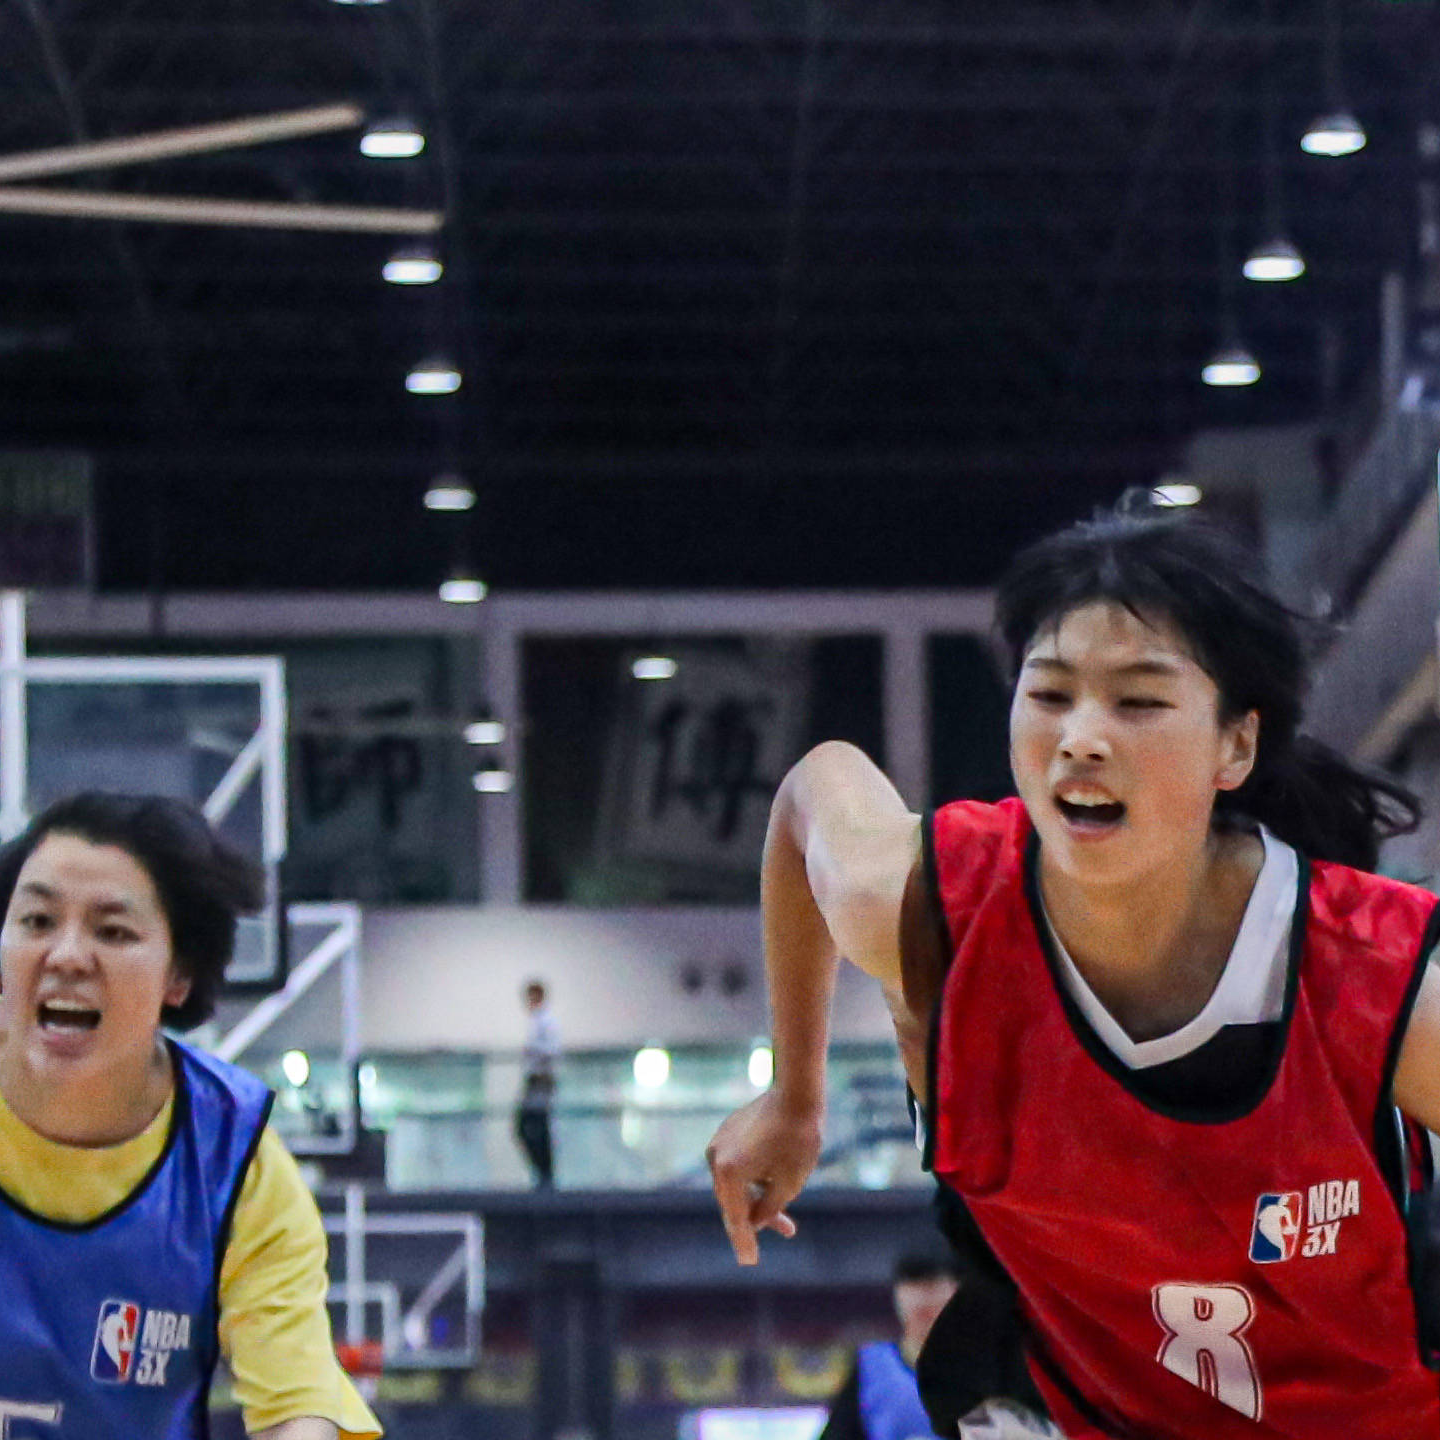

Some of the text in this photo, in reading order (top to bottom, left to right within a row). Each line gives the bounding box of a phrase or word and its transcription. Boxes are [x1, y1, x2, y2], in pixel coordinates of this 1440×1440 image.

[1307, 1180, 1360, 1226] NBA
[1301, 1221, 1341, 1258] 3X
[140, 1309, 191, 1350] NBA
[135, 1349, 172, 1387] 3X
